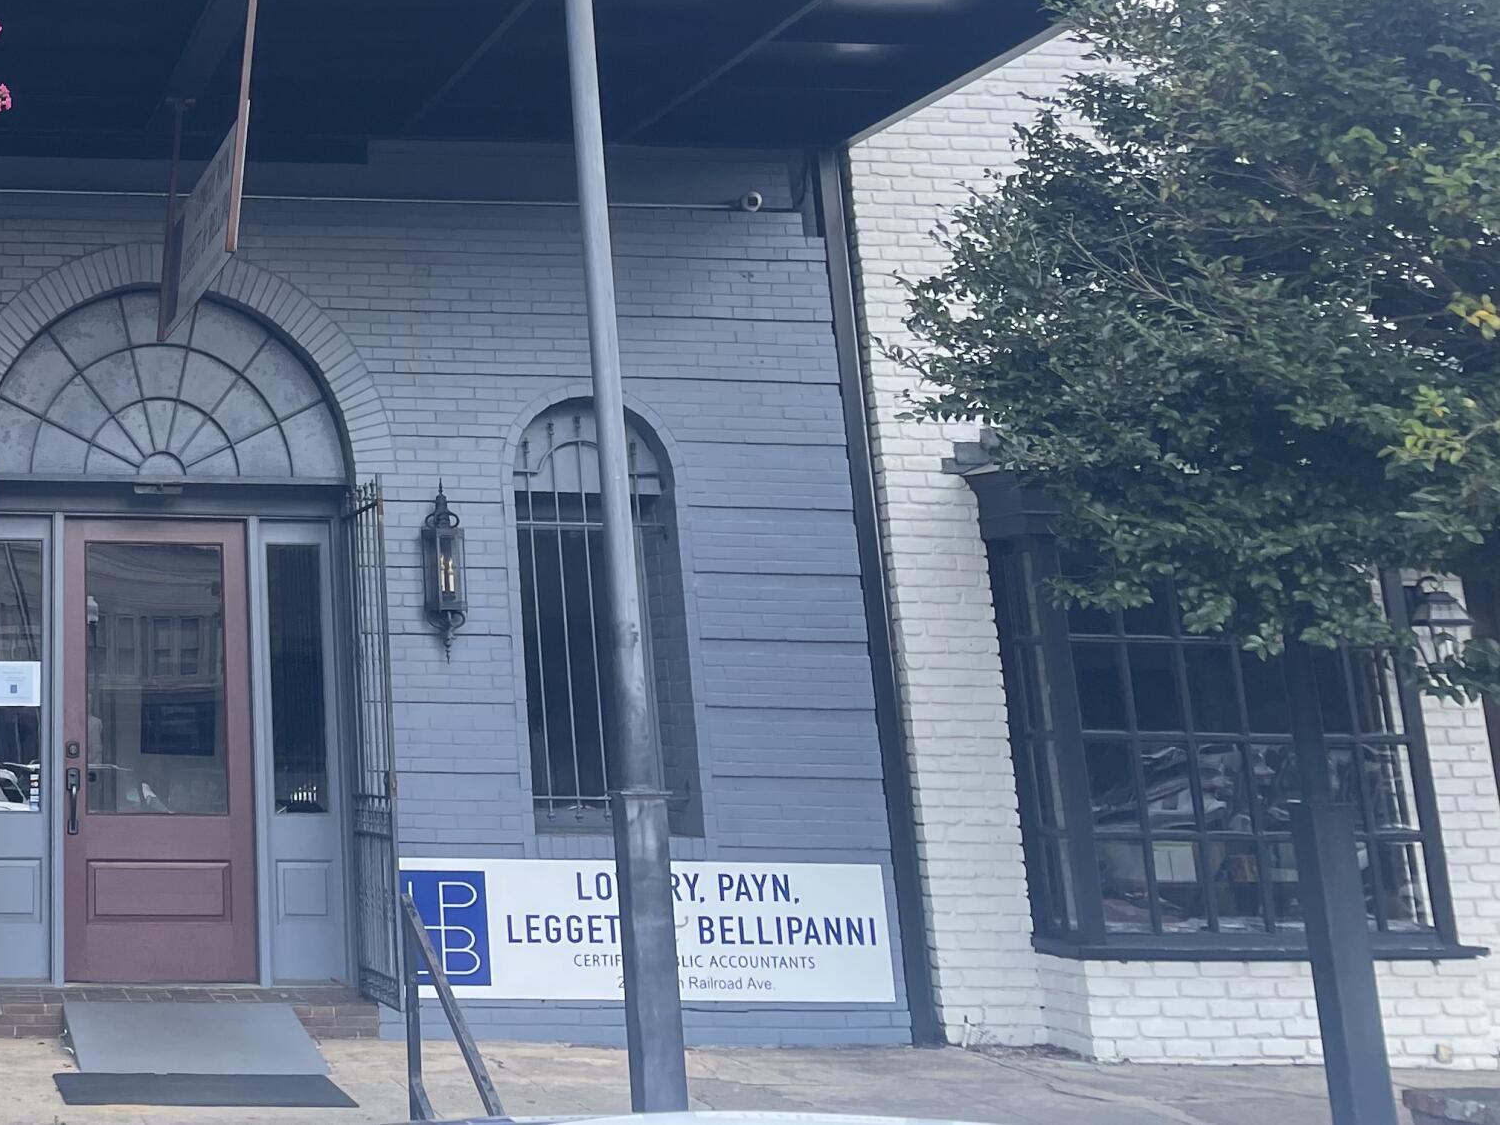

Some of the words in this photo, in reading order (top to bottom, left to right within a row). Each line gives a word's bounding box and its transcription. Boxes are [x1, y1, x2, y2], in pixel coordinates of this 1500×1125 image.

[718, 873, 800, 904] PAYN,
[506, 915, 622, 944] LEGGET
[698, 916, 877, 947] BELLIPANNI
[710, 956, 816, 970] ACCOUNTANTS
[689, 977, 743, 991] Railroad
[747, 978, 776, 992] Ave.
